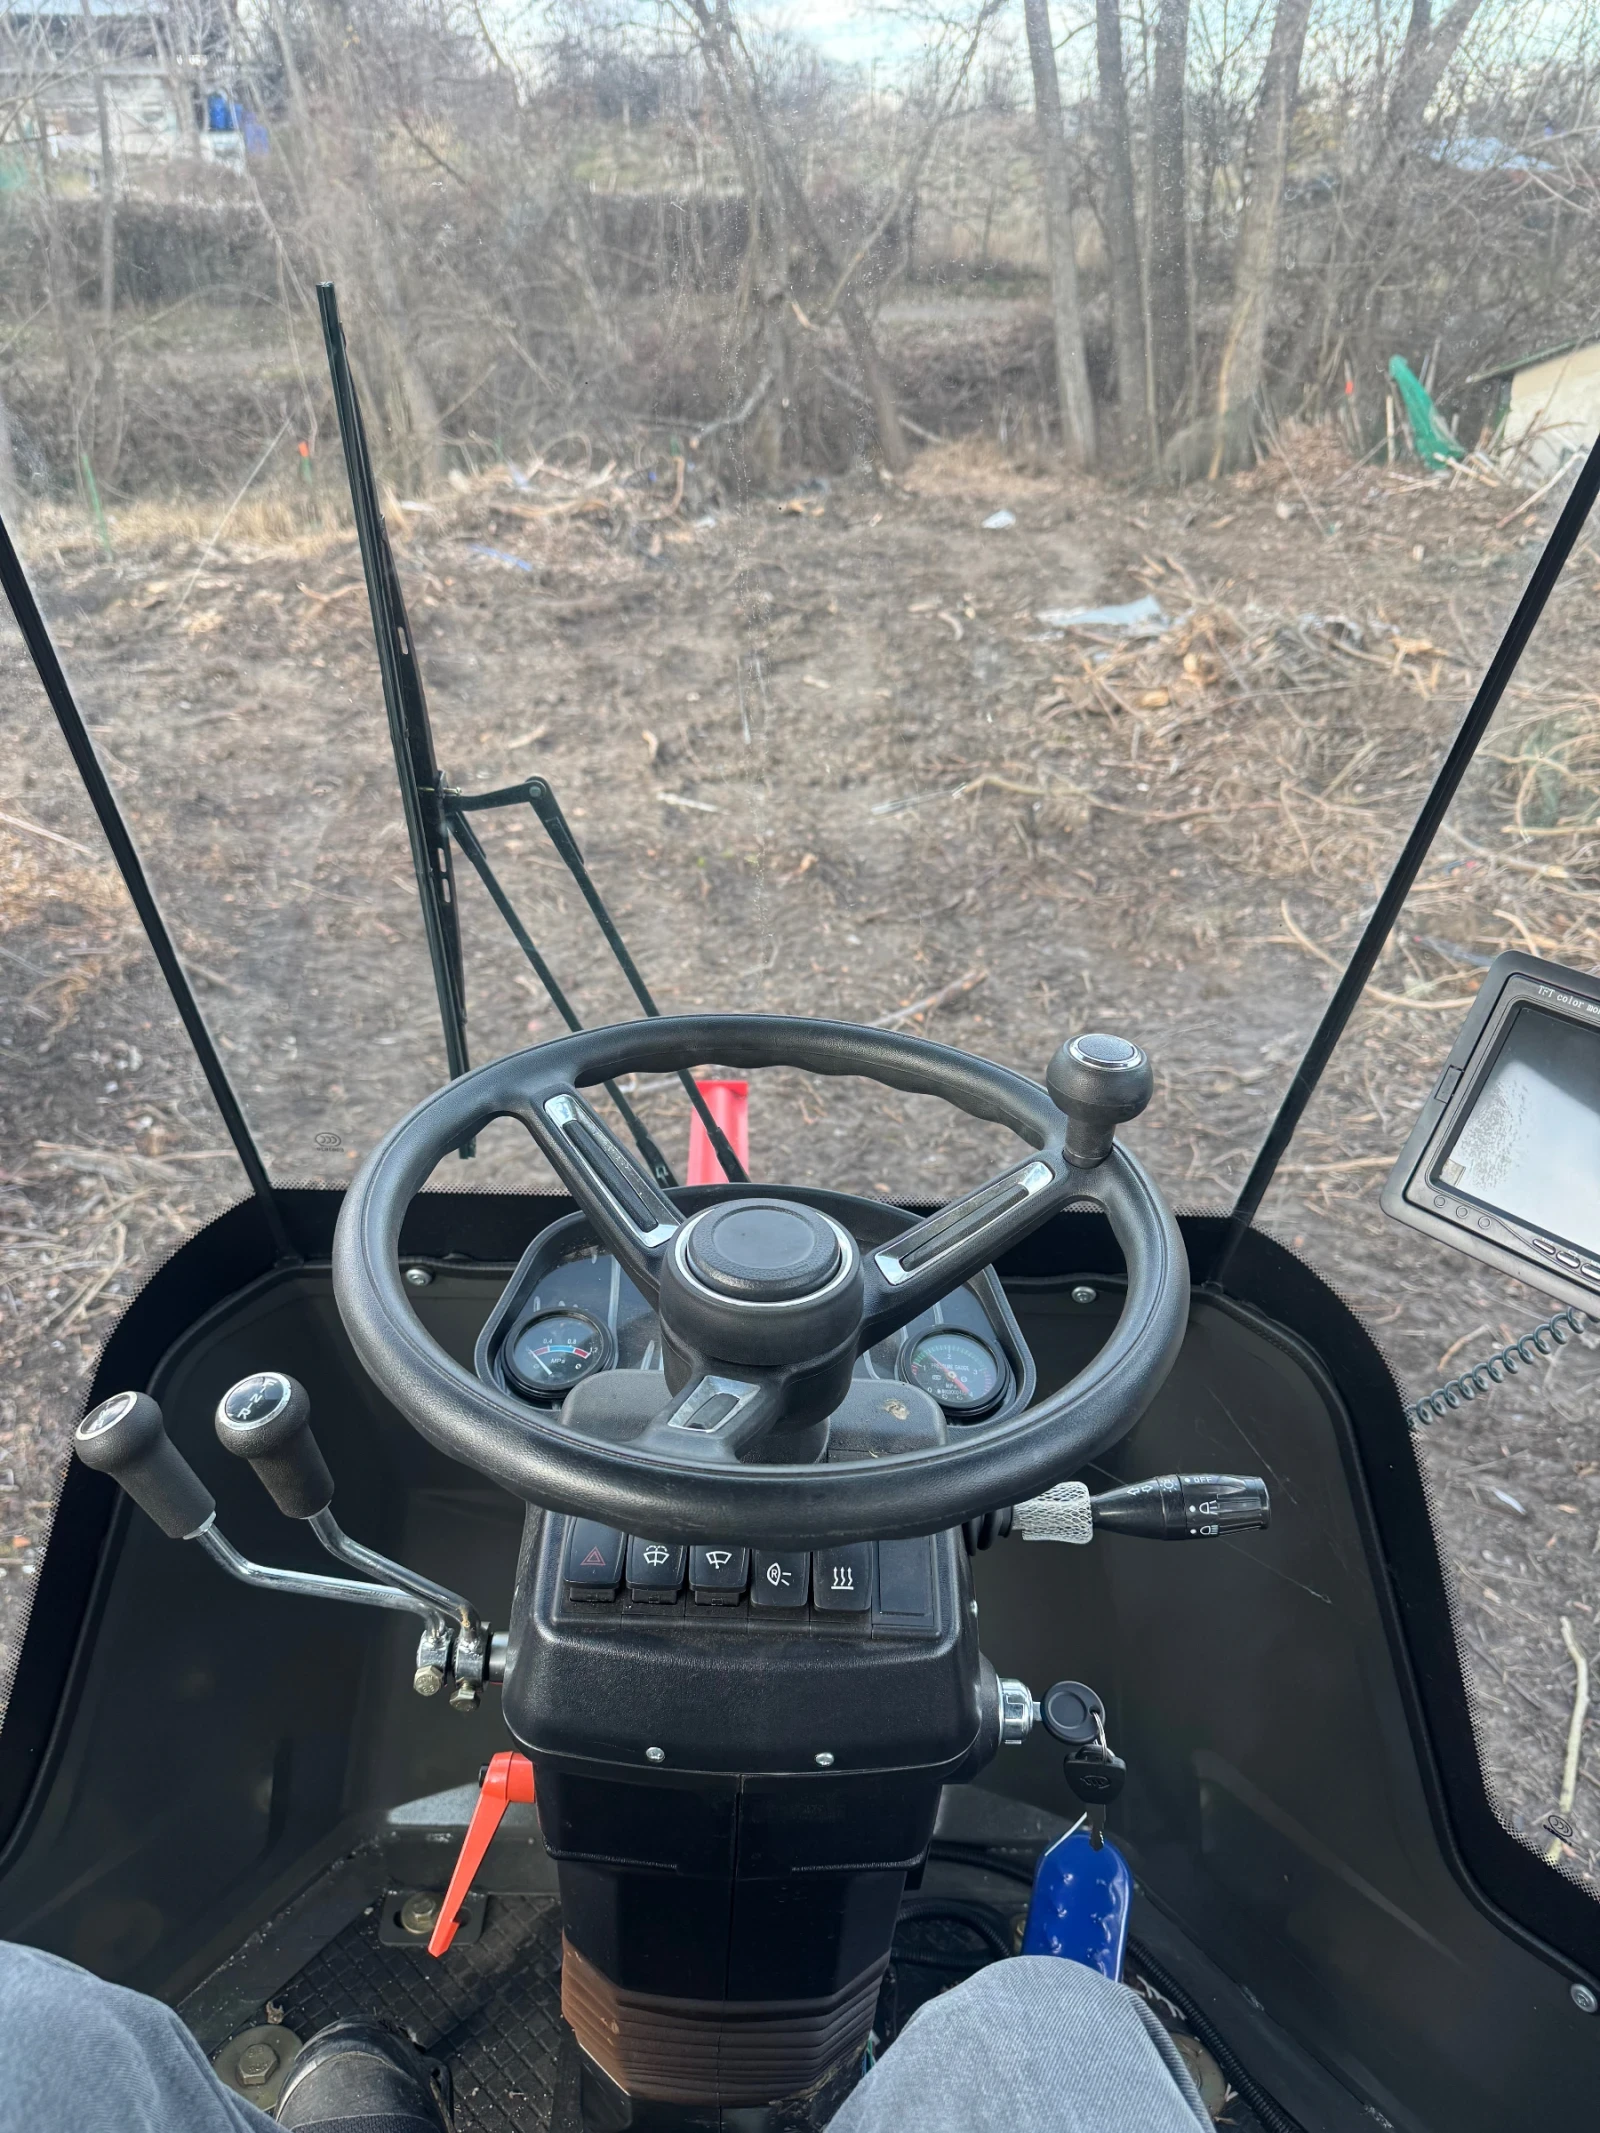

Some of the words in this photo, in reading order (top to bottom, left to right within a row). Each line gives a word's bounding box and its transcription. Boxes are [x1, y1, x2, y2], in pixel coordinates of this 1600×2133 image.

[1537, 985, 1556, 998] TFT
[1556, 993, 1585, 1009] color
[249, 1393, 263, 1403] N
[237, 1407, 251, 1420] R
[770, 1568, 778, 1579] R
